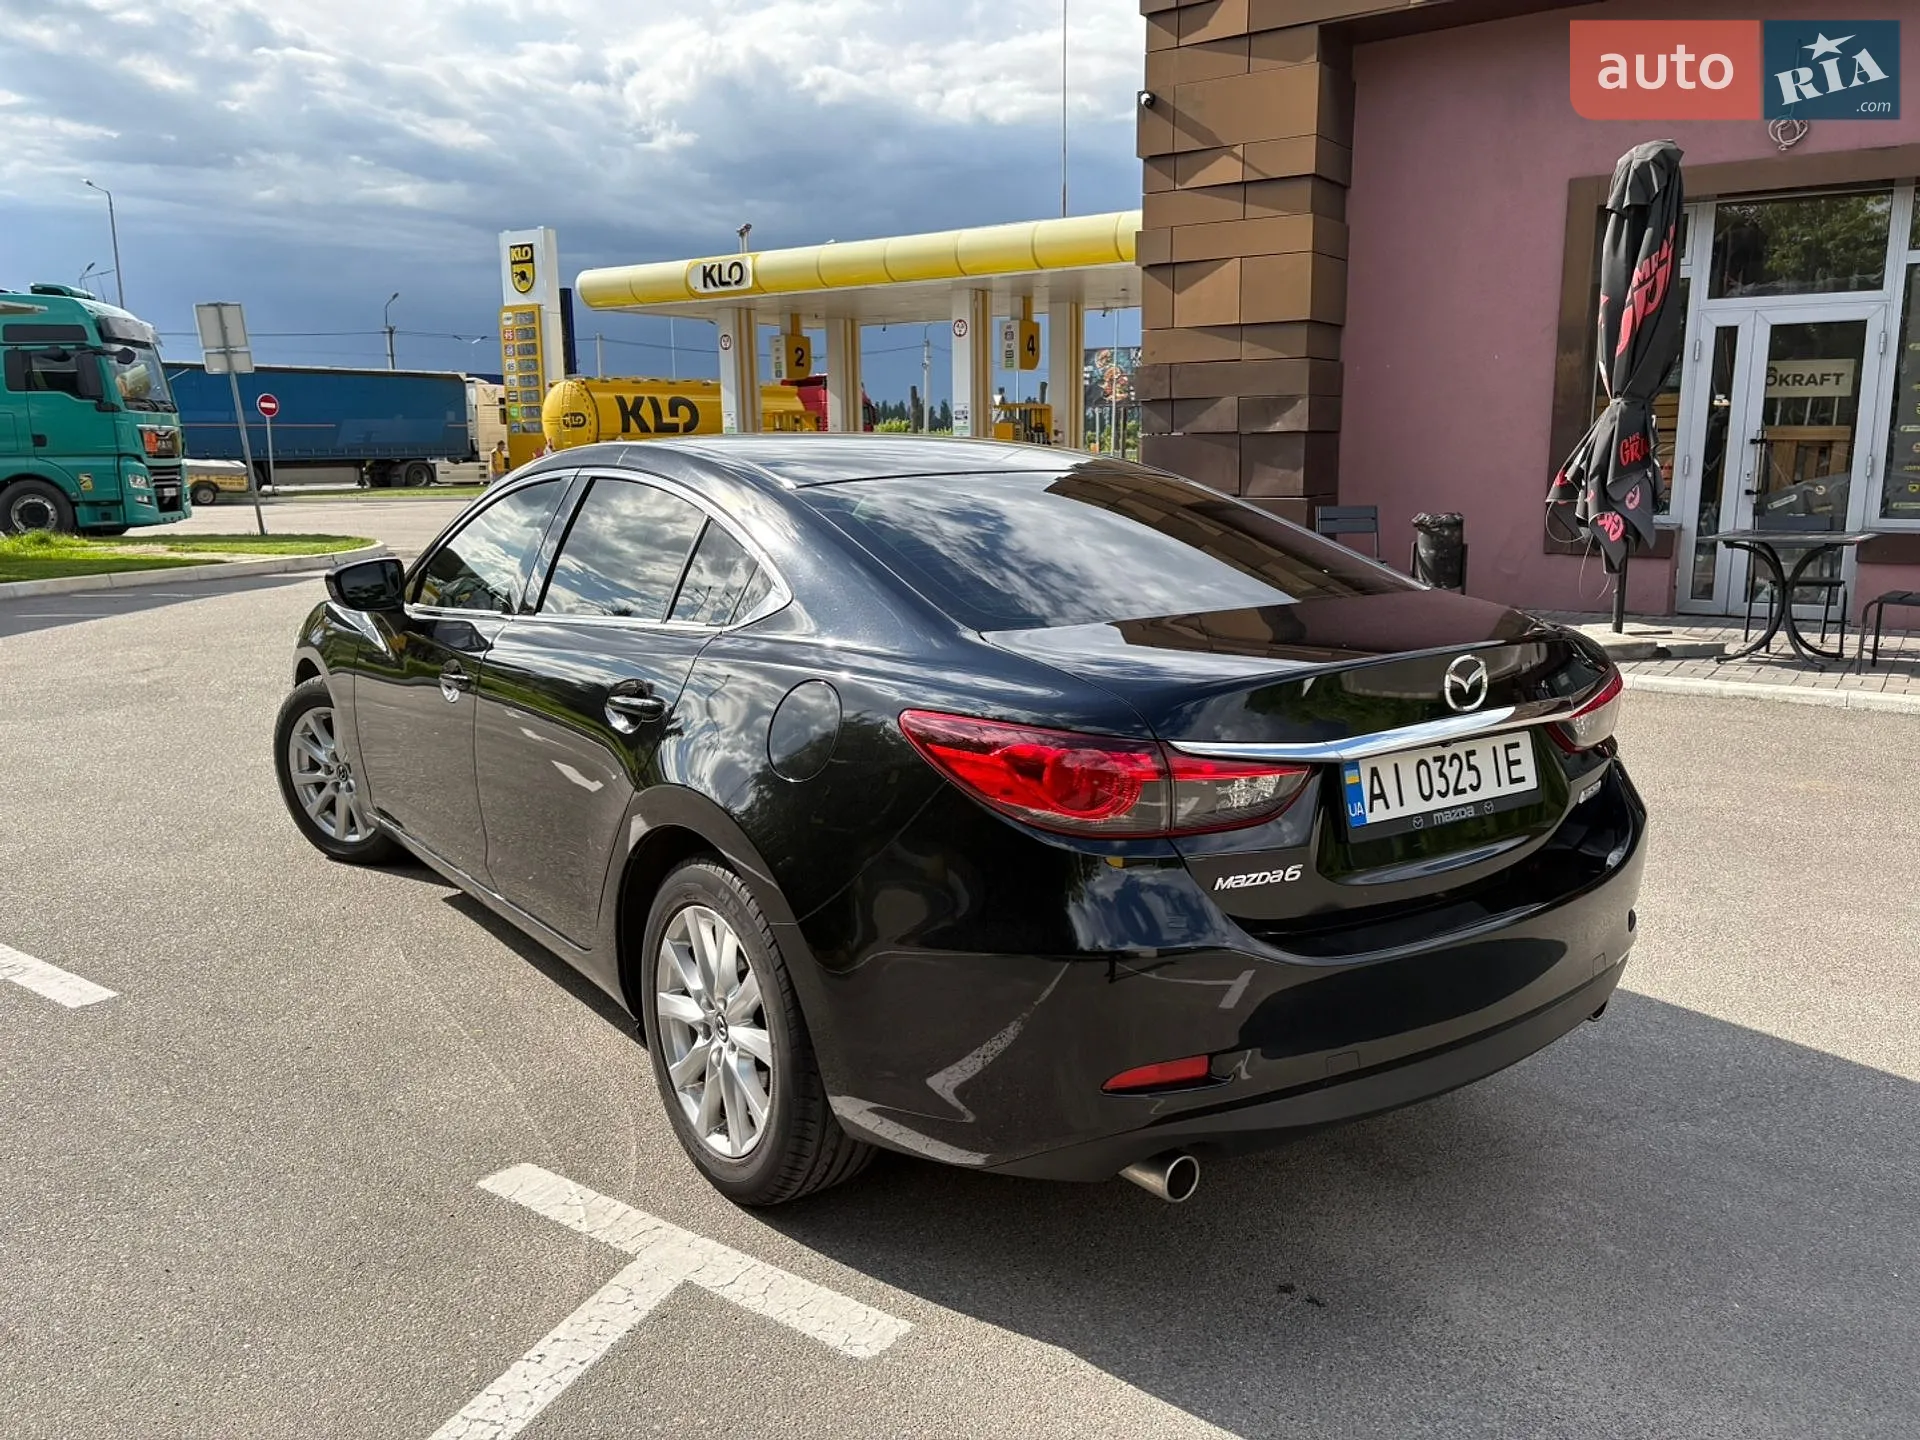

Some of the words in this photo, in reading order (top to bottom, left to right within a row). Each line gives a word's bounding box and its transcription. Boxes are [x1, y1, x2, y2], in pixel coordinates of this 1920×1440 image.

[511, 246, 532, 262] KLO
[702, 261, 744, 289] KLO
[795, 346, 805, 367] 2
[1027, 334, 1036, 357] 4
[615, 394, 700, 433] KLO
[1368, 762, 1404, 813] AI
[1415, 749, 1482, 802] 0325
[1492, 741, 1526, 788] IE
[1348, 801, 1365, 817] UA
